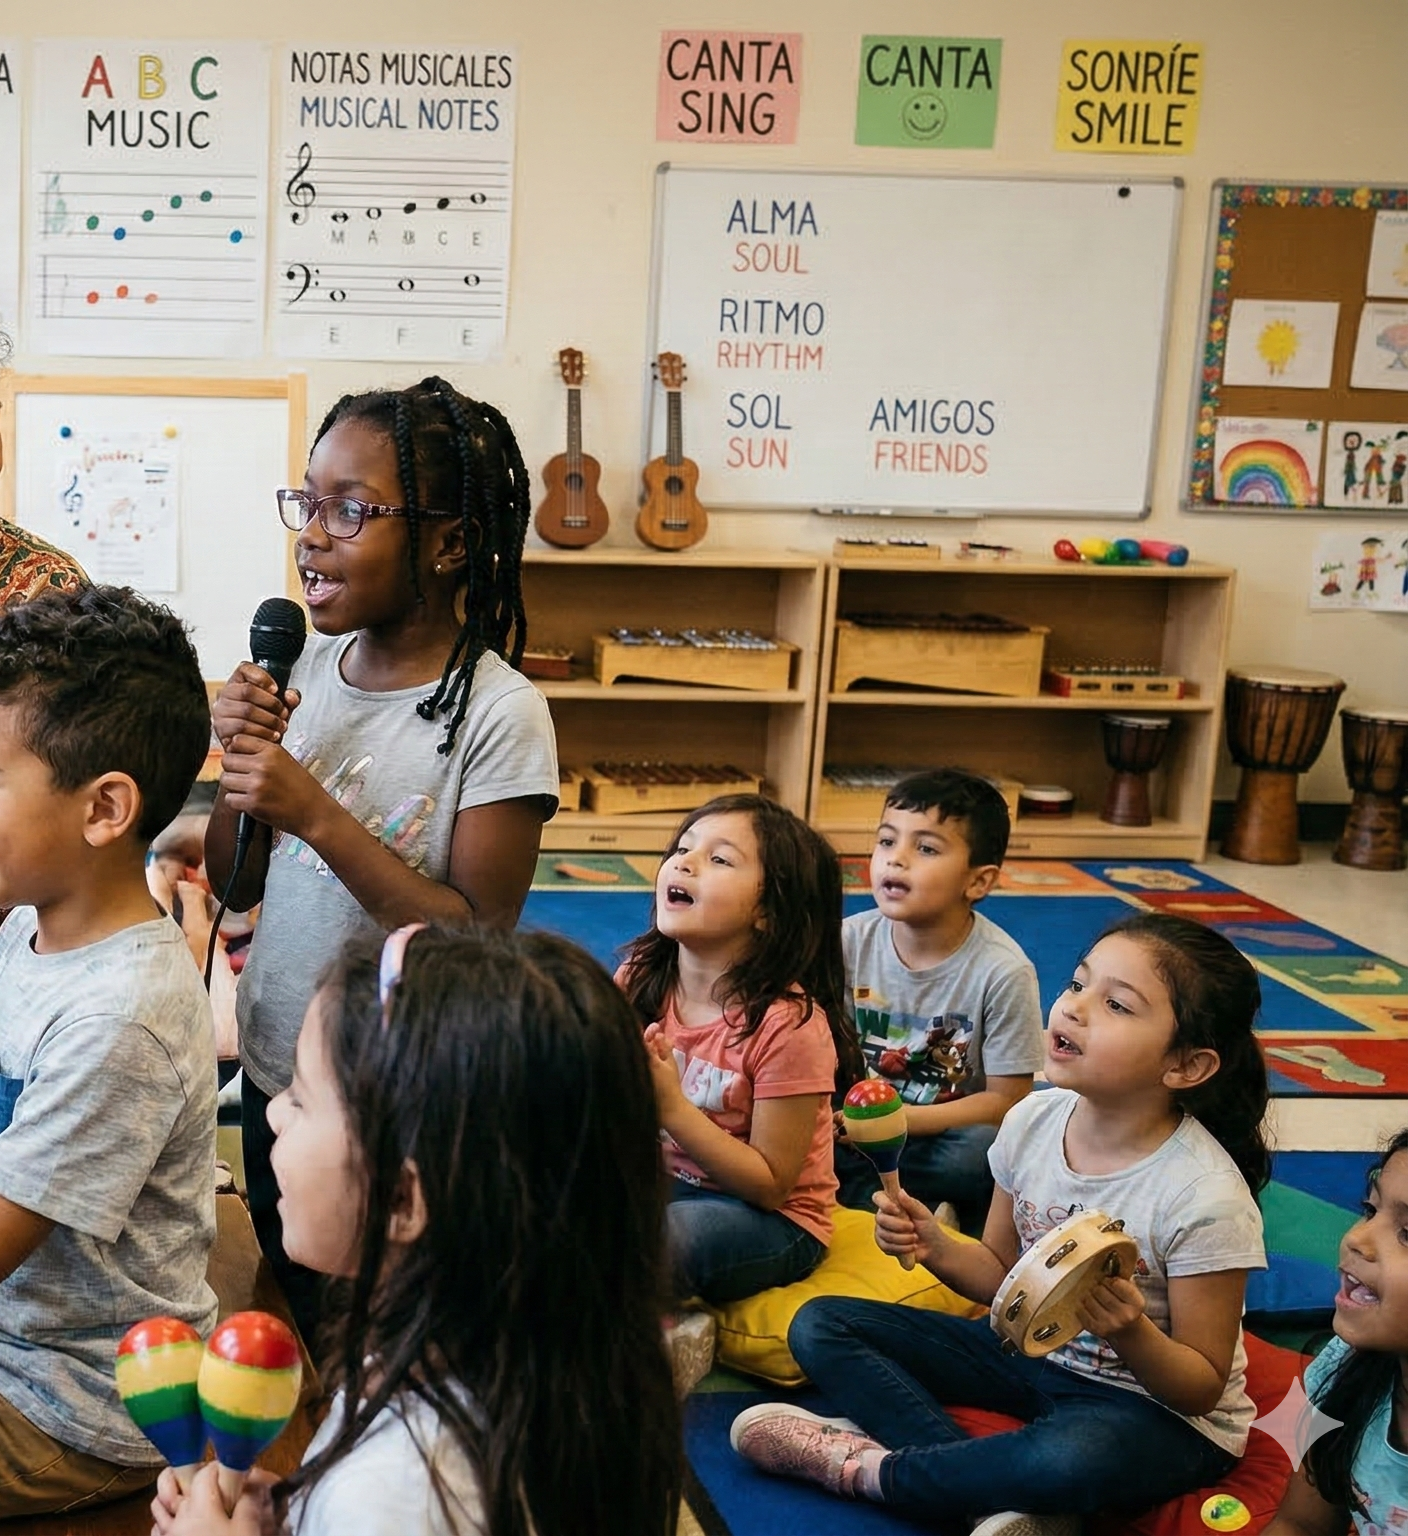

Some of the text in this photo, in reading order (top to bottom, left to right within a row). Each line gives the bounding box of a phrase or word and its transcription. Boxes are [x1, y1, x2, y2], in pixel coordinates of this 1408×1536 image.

[291, 51, 512, 89] NOTAS MUSICALES
[667, 38, 794, 84] CANTA
[866, 44, 993, 90] CANTA
[1067, 43, 1198, 96] SONRÍE
[87, 109, 210, 150] MUSIC
[300, 96, 500, 132] MUSICAL NOTES
[677, 89, 776, 136] SING
[1071, 100, 1187, 147] SMILE
[726, 199, 819, 236] ALMA
[732, 241, 809, 275] SOUL
[720, 298, 825, 336] RITMO
[717, 340, 823, 371] RHYTHM
[726, 392, 792, 430] SOL
[869, 397, 995, 436] AMIGOS
[726, 436, 788, 469] SUN
[875, 440, 988, 475] FRIENDS
